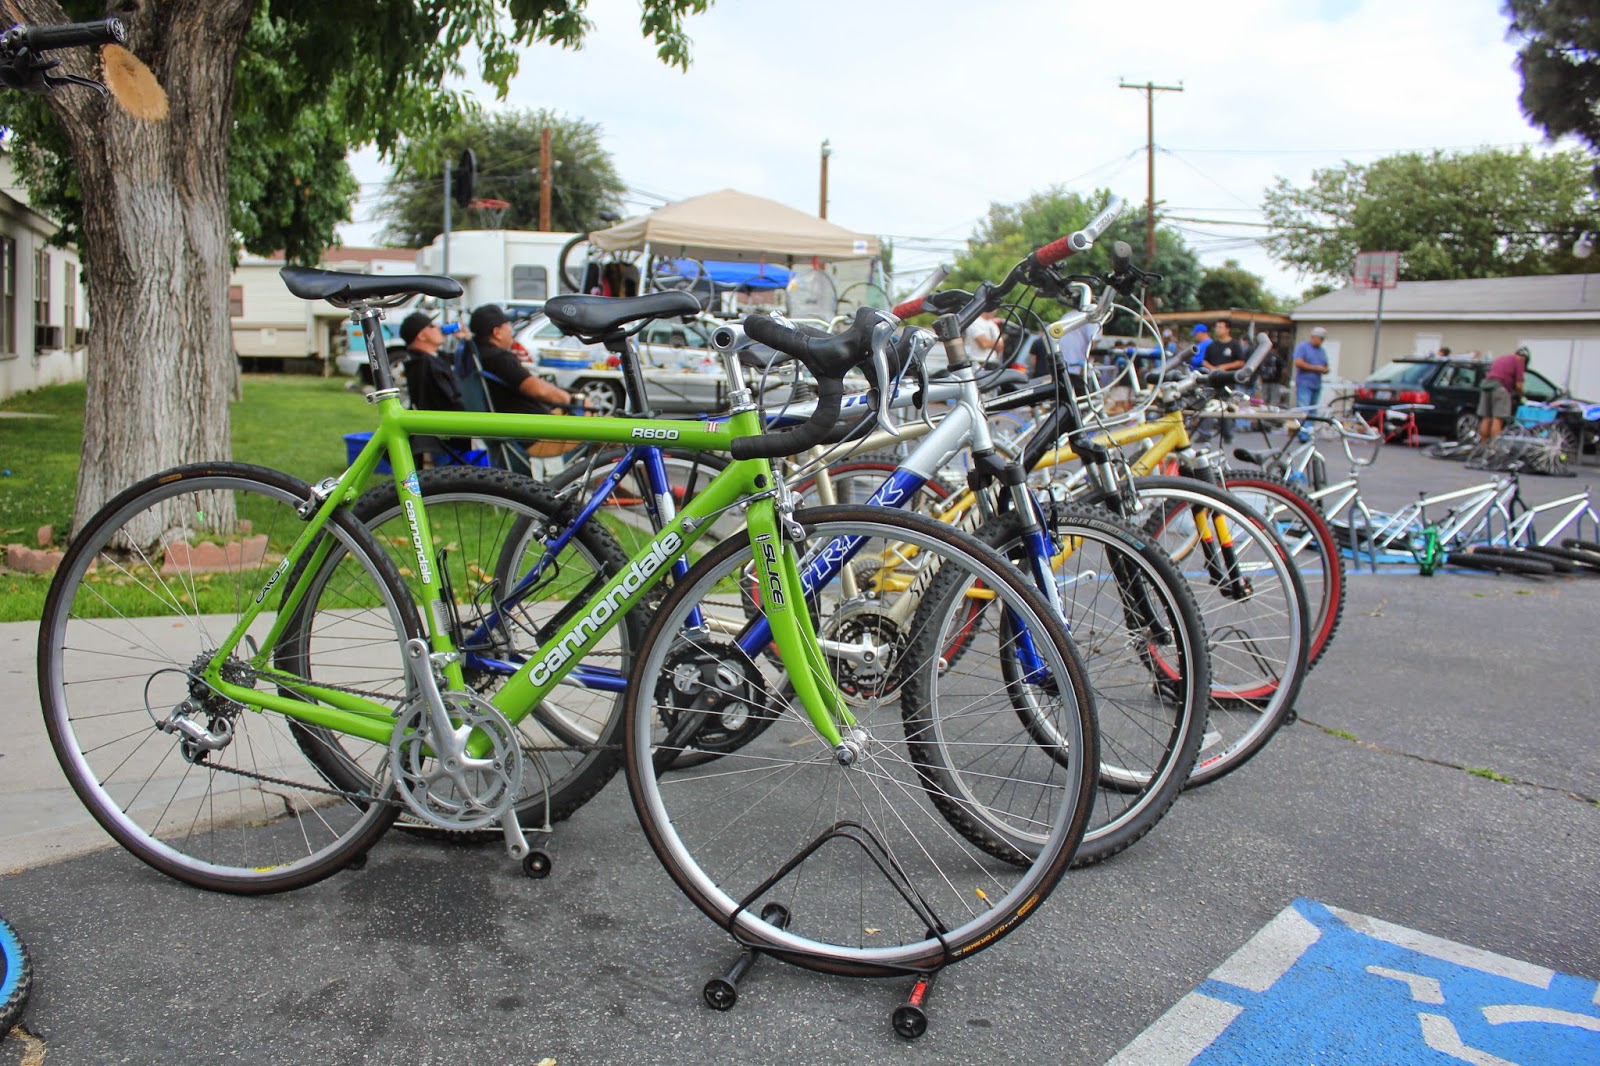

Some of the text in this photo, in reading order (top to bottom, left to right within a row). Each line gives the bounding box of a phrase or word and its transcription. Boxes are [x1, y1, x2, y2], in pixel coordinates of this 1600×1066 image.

[631, 427, 680, 441] R600
[404, 499, 432, 585] cannondale
[762, 543, 786, 605] SLICE
[528, 530, 684, 688] cannondale
